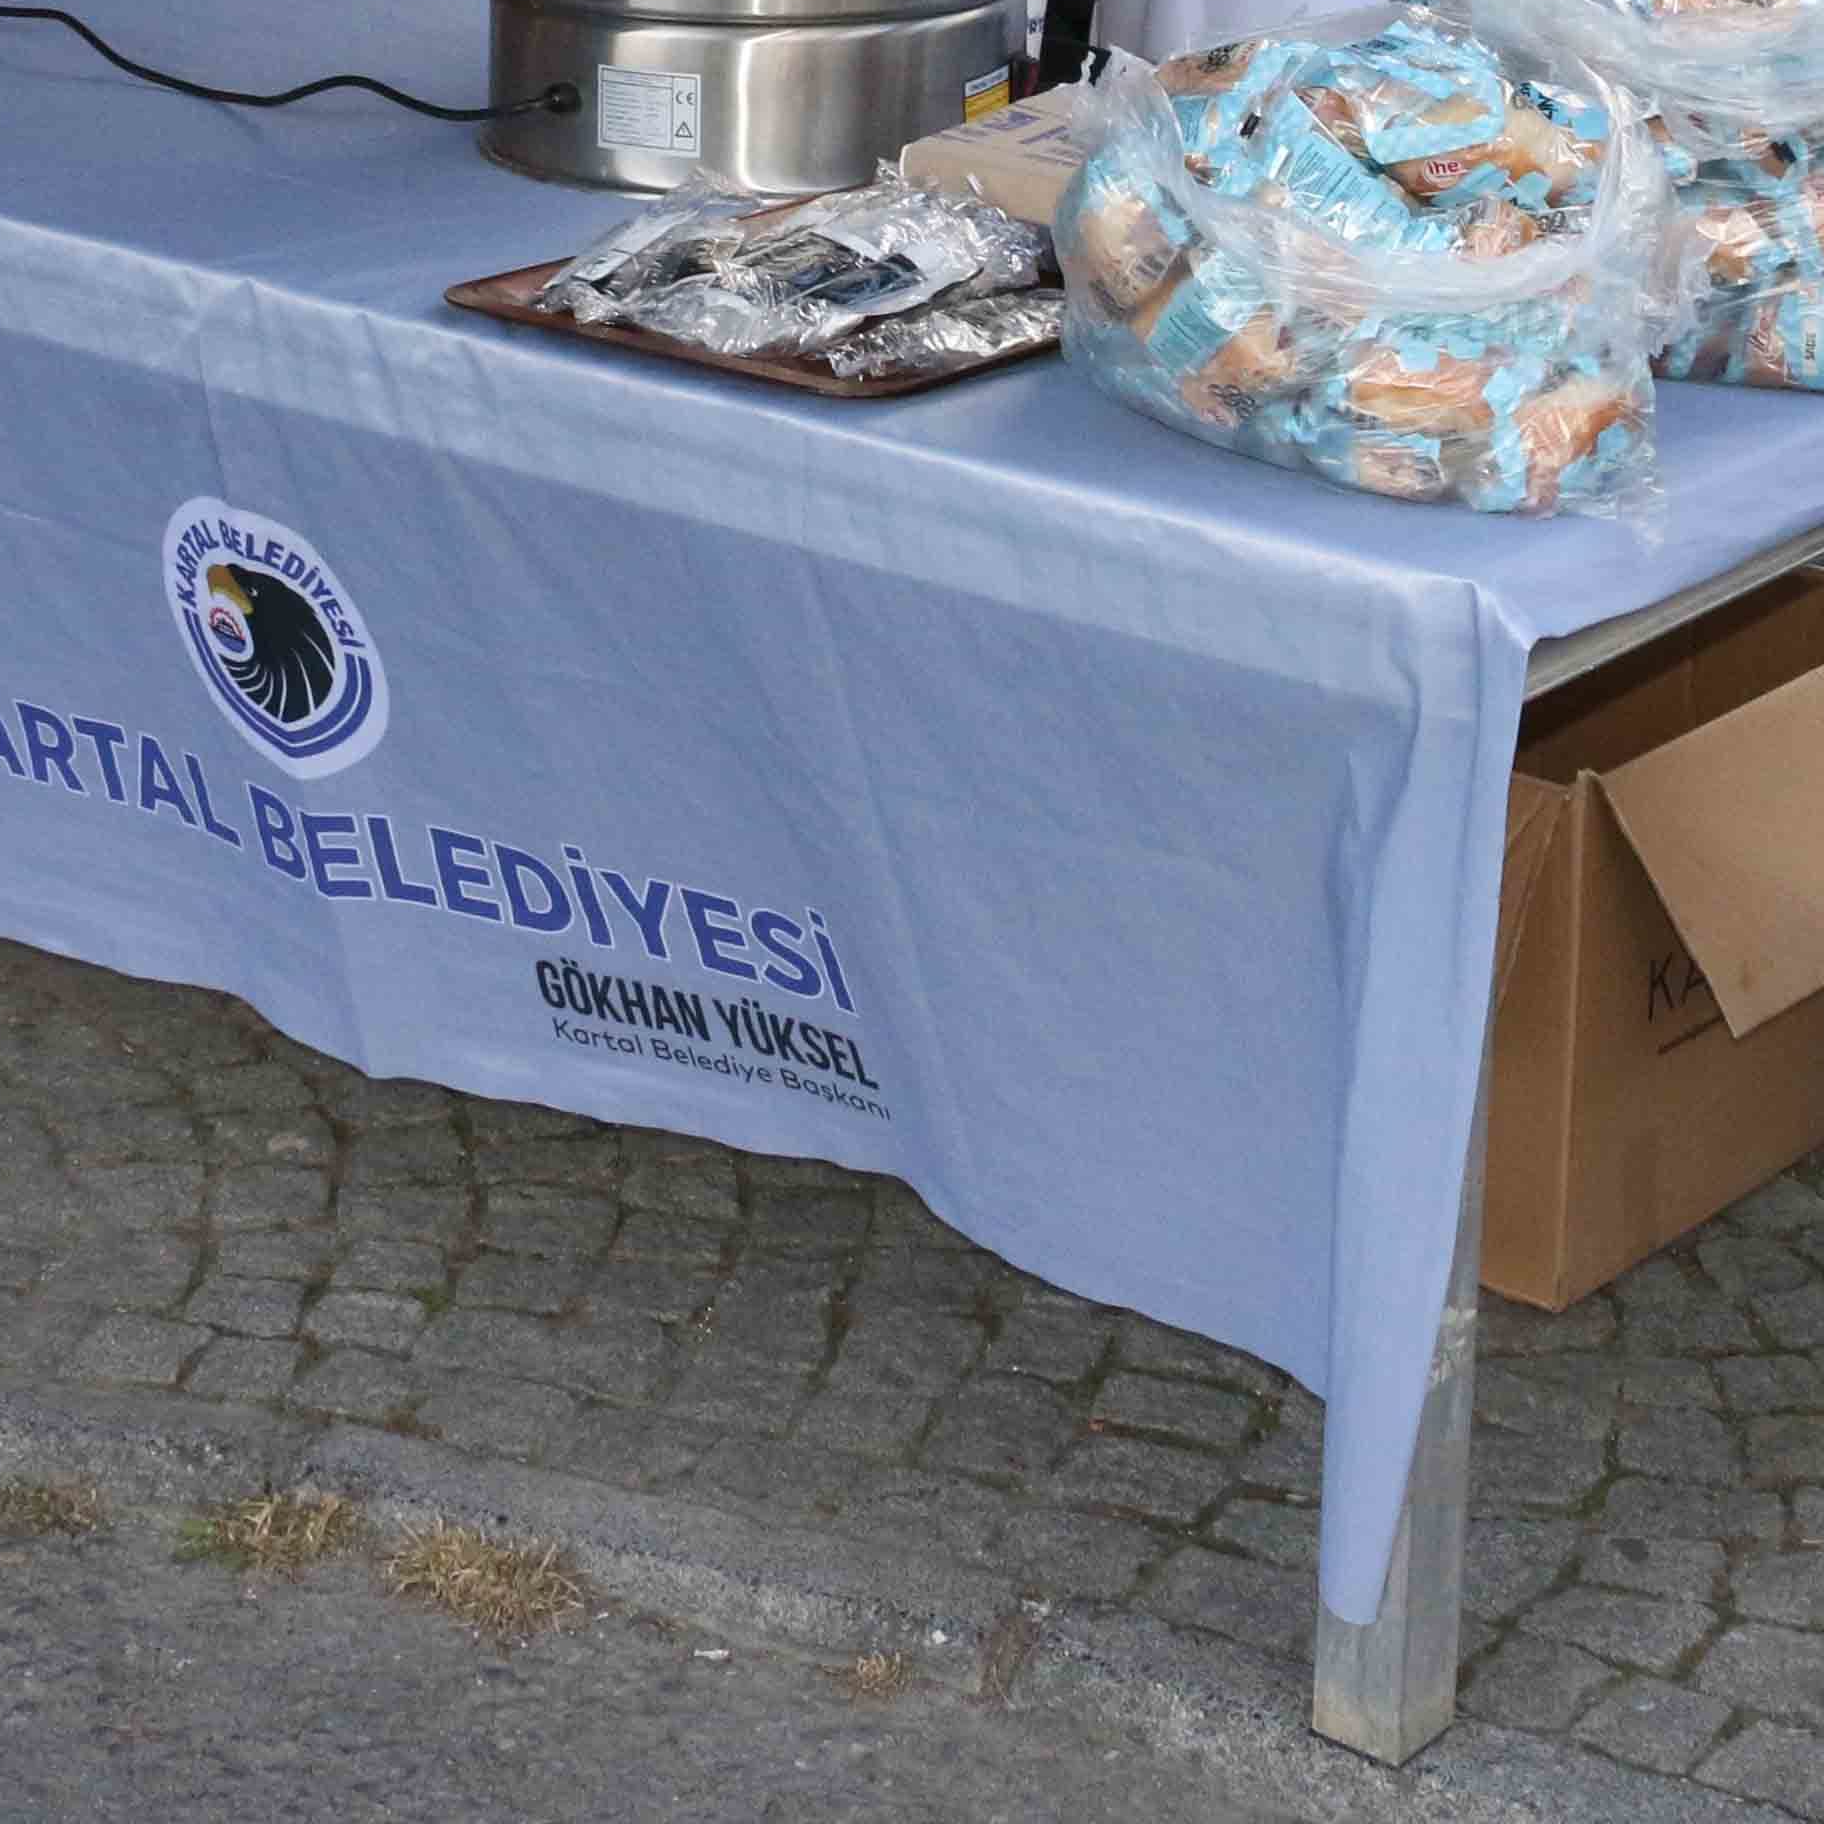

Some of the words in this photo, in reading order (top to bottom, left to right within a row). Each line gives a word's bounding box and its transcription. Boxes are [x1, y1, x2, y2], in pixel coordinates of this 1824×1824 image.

[177, 519, 220, 609] KARTAL
[218, 518, 366, 650] BELEDİYESİ
[246, 780, 858, 1016] BELEDİYESİ
[535, 957, 711, 1042] GÖKHAN
[712, 997, 880, 1091] YÜKSEL
[551, 1018, 643, 1056] Kartal
[650, 1038, 774, 1084] Belediye
